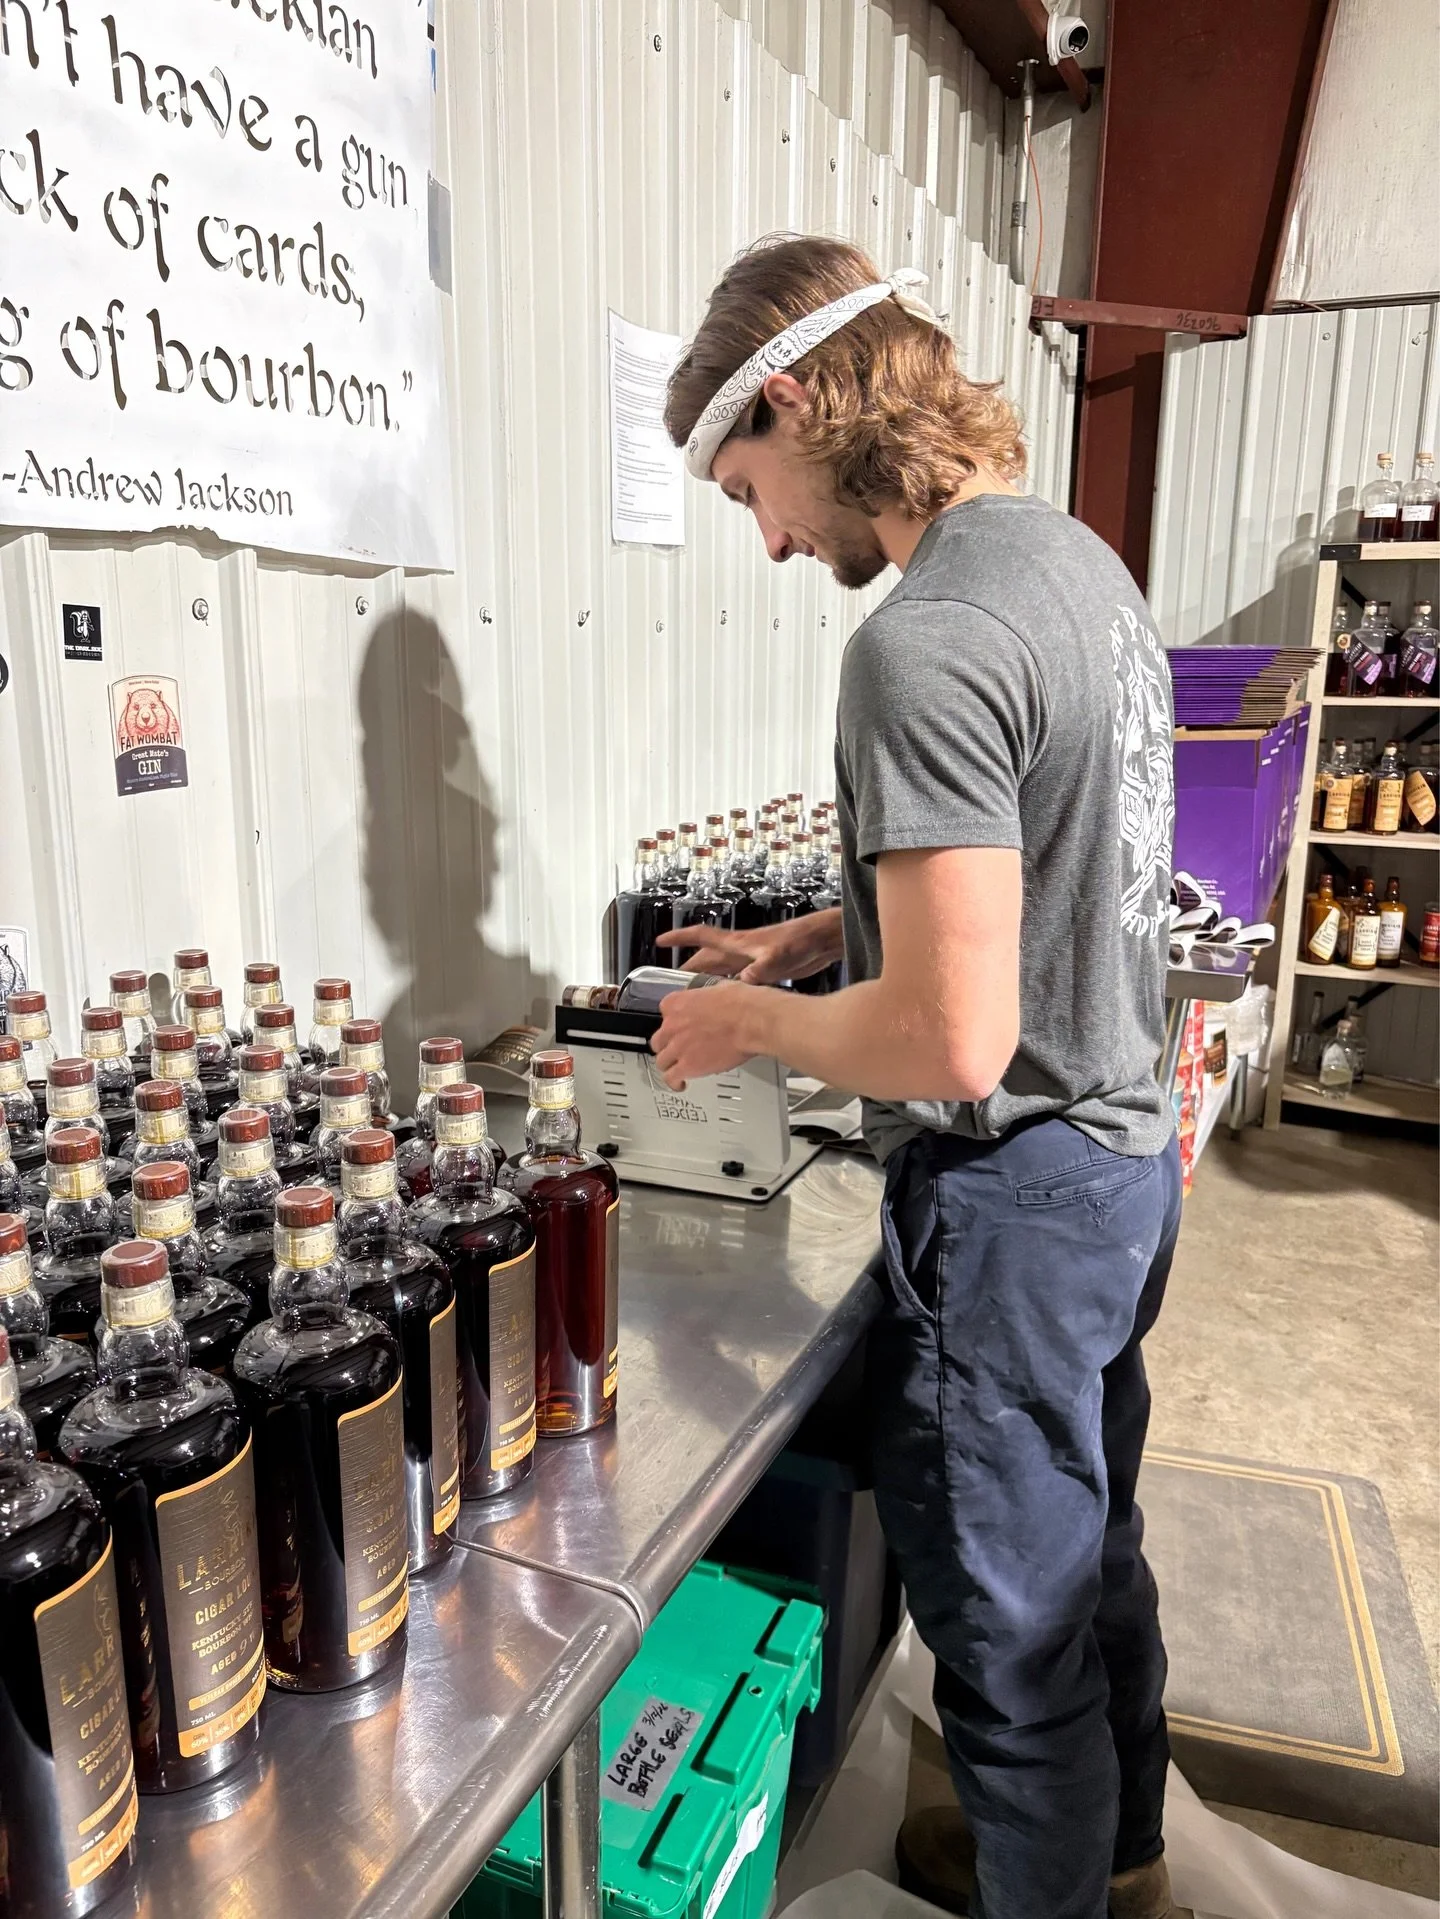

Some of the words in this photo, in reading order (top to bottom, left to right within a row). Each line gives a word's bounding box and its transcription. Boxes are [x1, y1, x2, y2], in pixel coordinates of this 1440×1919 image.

[101, 15, 272, 151] have
[294, 114, 323, 172] a
[104, 173, 169, 282] of
[197, 215, 364, 323] cards,
[61, 299, 126, 411] of
[3, 450, 163, 507] -Andrew
[175, 468, 294, 517] Jackson
[121, 735, 136, 752] FAT
[137, 731, 178, 746] WOMBAT
[138, 759, 162, 775] GIN
[195, 1592, 235, 1625] CIGAR
[192, 1613, 242, 1651] KENTUCKY
[199, 1623, 242, 1658] BOURBON
[211, 1650, 237, 1675] AGED
[80, 1696, 115, 1740] CIGAR
[191, 1718, 204, 1726] 750
[204, 1711, 217, 1721] ML
[607, 1732, 648, 1786] LARGE
[627, 1749, 667, 1798] BOTTLE
[659, 1707, 696, 1751] SEALS
